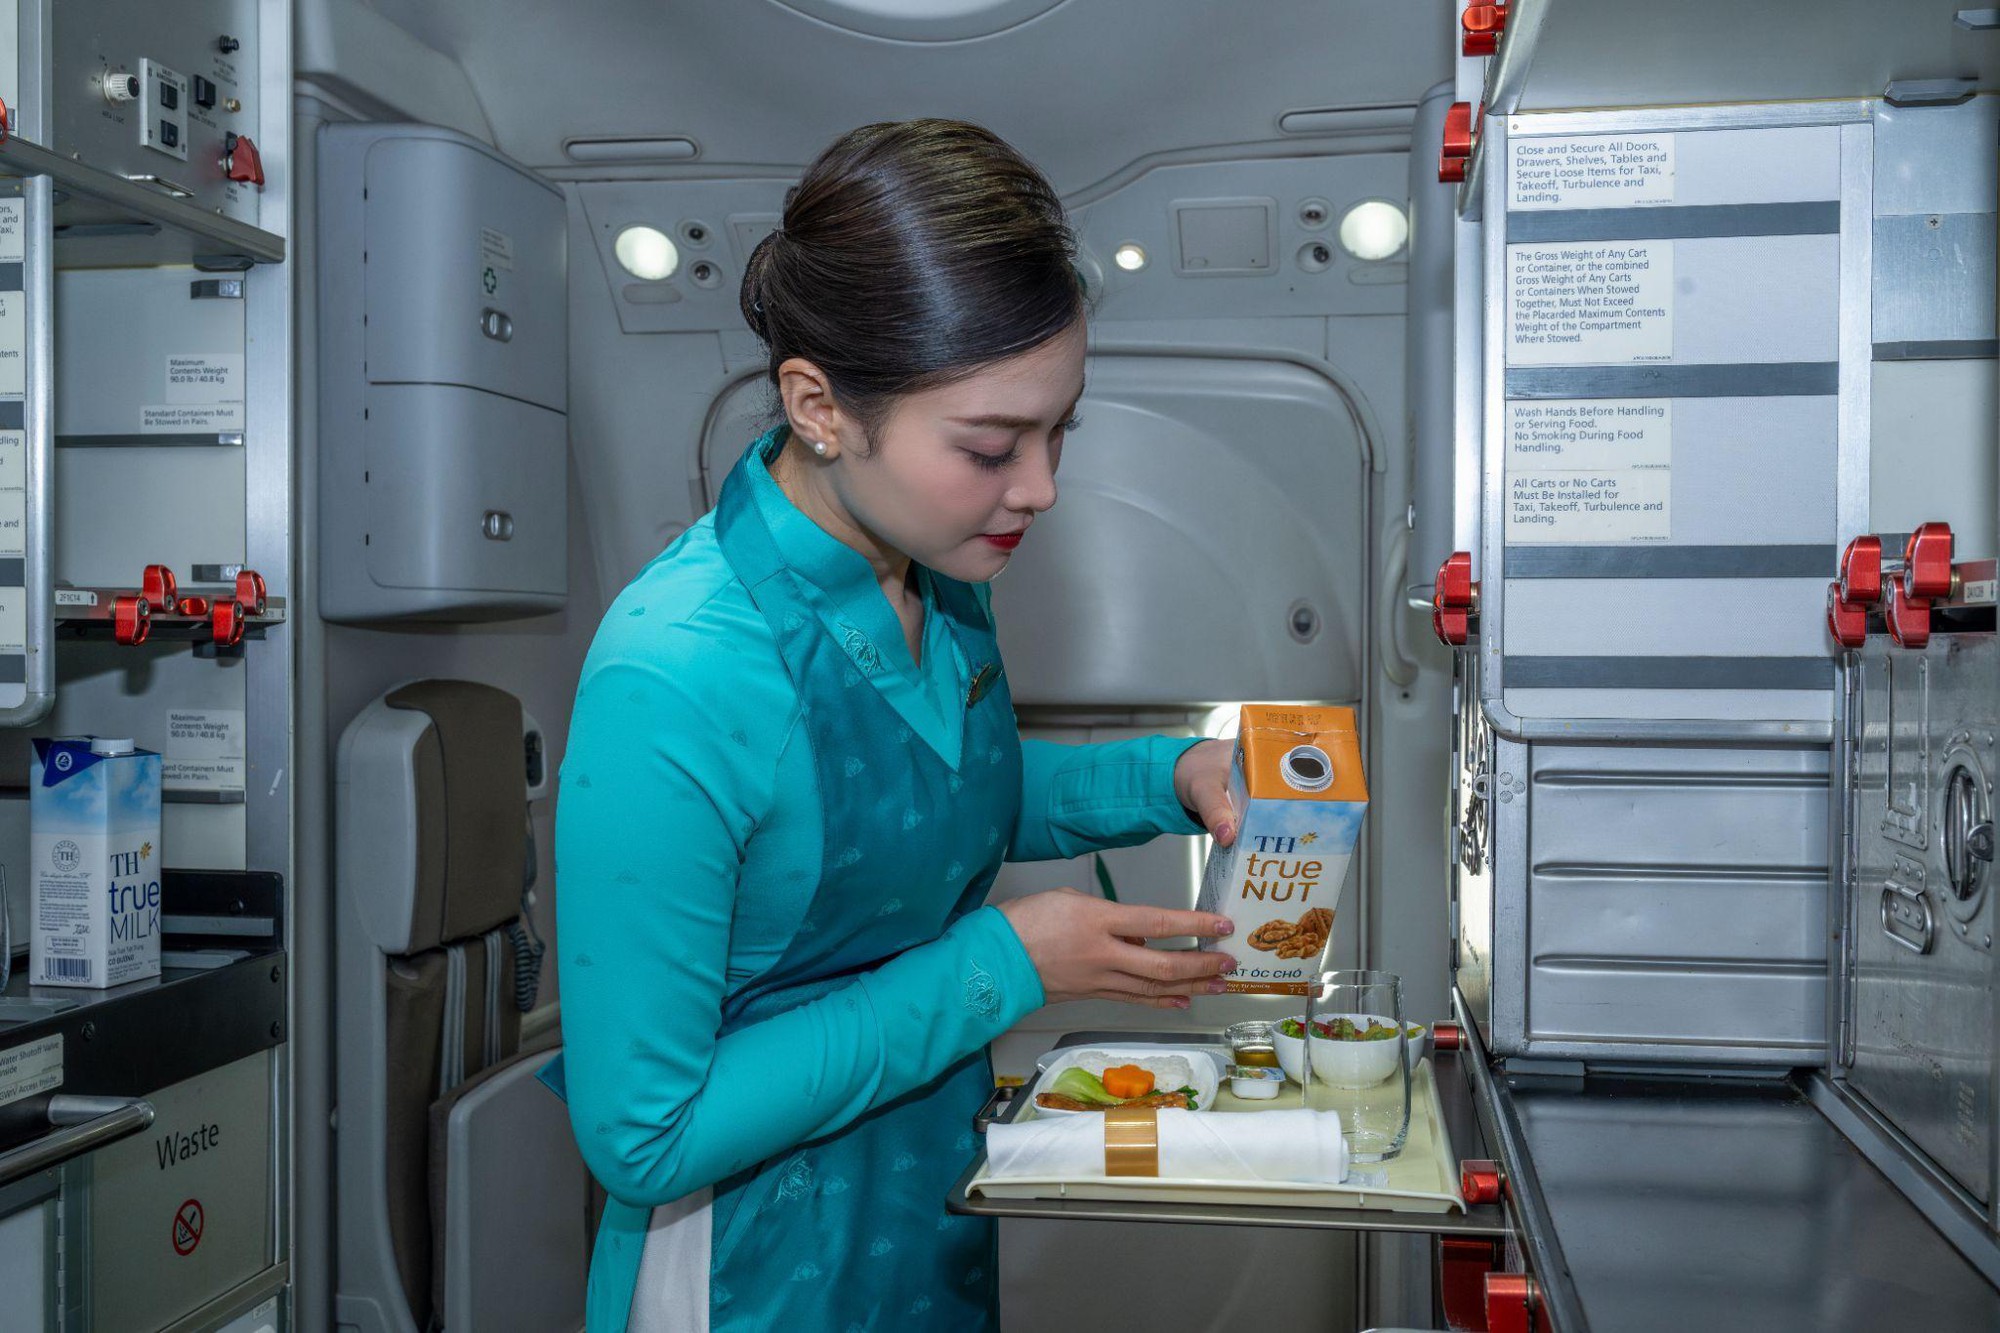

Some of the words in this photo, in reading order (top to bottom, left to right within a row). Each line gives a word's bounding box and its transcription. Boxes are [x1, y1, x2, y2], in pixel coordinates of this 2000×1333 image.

[1517, 146, 1544, 155] Close
[1547, 145, 1567, 154] and
[1570, 143, 1604, 153] Secure
[1609, 143, 1622, 151] All
[1626, 142, 1659, 151] Doors,
[1517, 157, 1562, 167] Drawers,
[1567, 154, 1606, 165] Shelves,
[1610, 154, 1643, 163] Tables
[1647, 153, 1666, 162] and
[1517, 170, 1550, 179] Secure
[1555, 168, 1584, 177] Loose
[1588, 167, 1615, 176] Items
[1619, 166, 1634, 175] for
[1638, 165, 1661, 175] Taxi,
[1517, 180, 1558, 191] Takeoff,
[1564, 179, 1620, 189] Turbulence
[1624, 178, 1644, 187] and
[1517, 192, 1561, 203] Landing.
[3, 215, 18, 223] and
[0, 226, 14, 234] axi,
[1516, 252, 1532, 261] The
[1535, 252, 1558, 260] Gross
[1561, 251, 1593, 261] Weight
[1596, 250, 1605, 258] of
[1608, 250, 1625, 260] Any
[1628, 249, 1647, 258] Cart
[1528, 264, 1572, 274] Container,
[1588, 262, 1602, 270] the
[1605, 261, 1649, 269] combined
[1516, 276, 1539, 285] Gross
[1542, 275, 1573, 285] Weight
[1577, 274, 1586, 283] of
[1589, 274, 1606, 284] Any
[1609, 273, 1631, 282] Carts
[1528, 287, 1575, 296] Containers
[1578, 286, 1603, 294] When
[1606, 285, 1639, 294] Stowed
[1516, 299, 1556, 309] Together,
[1559, 298, 1581, 306] Must
[1584, 298, 1600, 306] Not
[1603, 297, 1633, 305] Exceed
[1516, 311, 1529, 320] the
[1533, 310, 1575, 319] Placarded
[1579, 309, 1623, 318] Maximum
[1626, 308, 1665, 317] Contents
[1516, 322, 1547, 333] Weight
[1550, 322, 1559, 330] of
[1563, 321, 1576, 330] the
[1580, 321, 1641, 331] Compartment
[1516, 334, 1544, 343] Where
[1547, 333, 1582, 343] Stowed.
[216, 376, 224, 384] kg
[145, 410, 176, 418] Standard
[1515, 408, 1542, 417] Wash
[1546, 408, 1576, 416] Hands
[1580, 407, 1613, 416] Before
[1618, 406, 1664, 417] Handling
[1529, 420, 1565, 430] Serving
[1569, 420, 1597, 428] Food.
[1515, 432, 1528, 440] No
[1532, 432, 1575, 442] Smoking
[1580, 431, 1614, 441] During
[1618, 431, 1643, 439] Food
[1515, 444, 1563, 454] Handling.
[1514, 479, 1527, 488] All
[1531, 479, 1556, 487] Carts
[1573, 479, 1587, 487] No
[1591, 478, 1616, 487] Carts
[1514, 491, 1539, 499] Must
[1542, 491, 1554, 499] Be
[1558, 490, 1600, 499] Installed
[1604, 490, 1619, 498] for
[1514, 503, 1535, 512] Taxi,
[1540, 502, 1579, 512] Takeoff,
[1585, 502, 1640, 511] Turbulence
[1643, 502, 1662, 510] and
[4, 520, 19, 528] and
[1514, 515, 1556, 525] Landing.
[171, 722, 201, 730] Contents
[203, 723, 229, 731] Weight
[216, 731, 225, 739] kg
[1255, 836, 1297, 853] TH
[110, 851, 139, 878] TH
[1247, 854, 1322, 879] true
[1242, 880, 1318, 902] NUT
[109, 881, 159, 915] true
[110, 907, 160, 944] MILK
[157, 1123, 219, 1170] Waste
